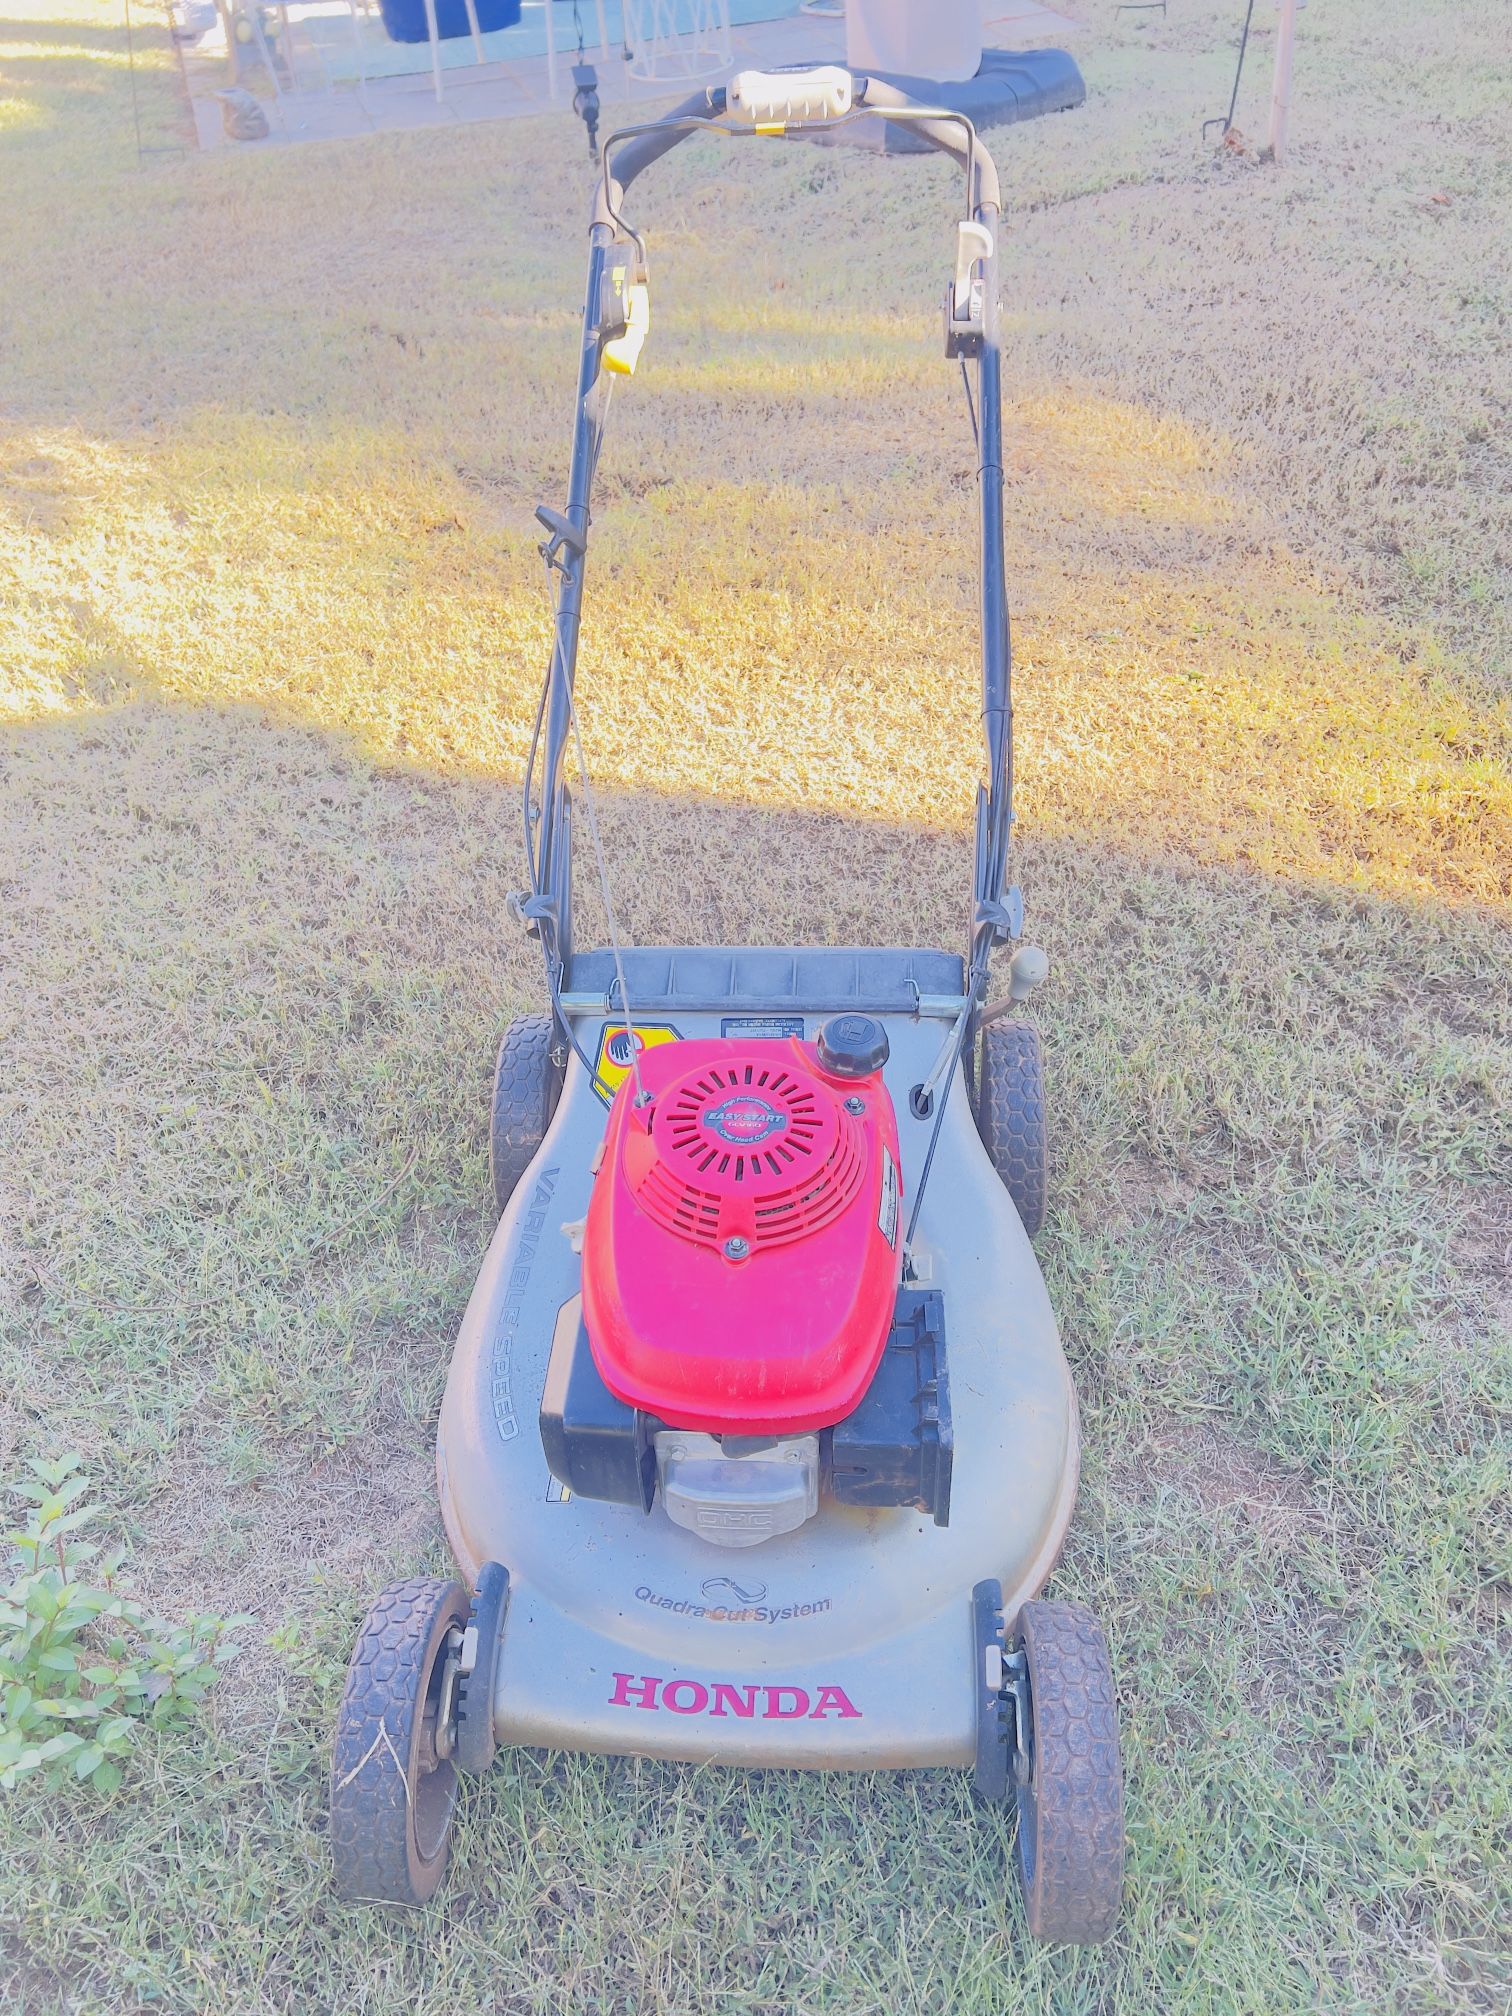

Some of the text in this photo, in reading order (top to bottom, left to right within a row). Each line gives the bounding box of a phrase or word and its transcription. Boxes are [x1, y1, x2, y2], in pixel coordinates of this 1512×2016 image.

[708, 1112, 783, 1122] EASY START
[755, 1131, 769, 1141] Cam
[490, 1167, 560, 1442] VARIABLE SPEED
[634, 1586, 832, 1624] Quadra Cut System
[608, 1672, 863, 1719] HONDA
